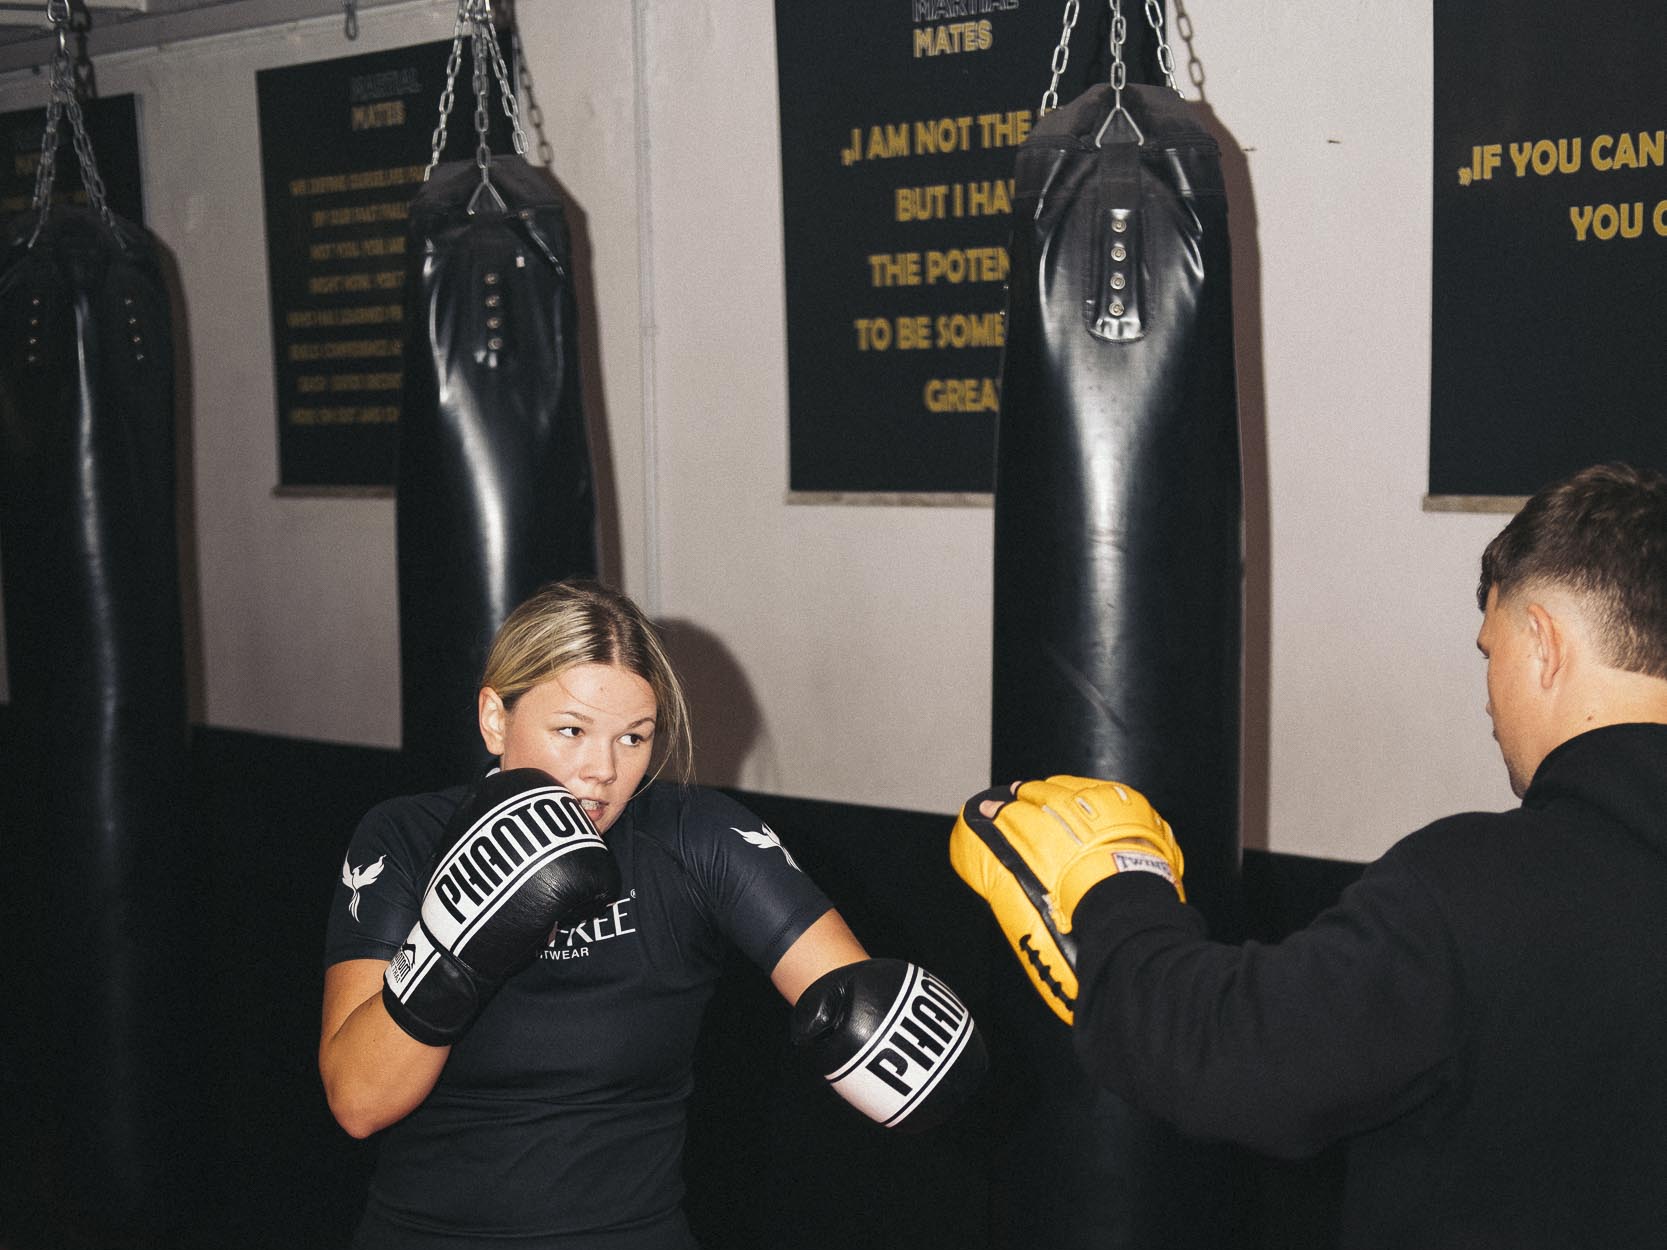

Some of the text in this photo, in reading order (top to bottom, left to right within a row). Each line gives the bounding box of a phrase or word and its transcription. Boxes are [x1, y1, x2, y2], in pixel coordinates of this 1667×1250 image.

[913, 19, 993, 58] MATES
[866, 123, 910, 160] AM
[914, 116, 973, 155] NOT
[977, 110, 1032, 149] THE
[1510, 137, 1582, 177] YOU
[1591, 130, 1667, 172] CAN
[895, 184, 949, 222] BUT
[952, 183, 964, 218] I
[1570, 202, 1644, 241] YOU
[868, 253, 922, 287] THE
[854, 318, 892, 351] TO
[896, 316, 931, 350] BE
[538, 946, 590, 961] TWEAR
[865, 969, 966, 1097] PHAN
